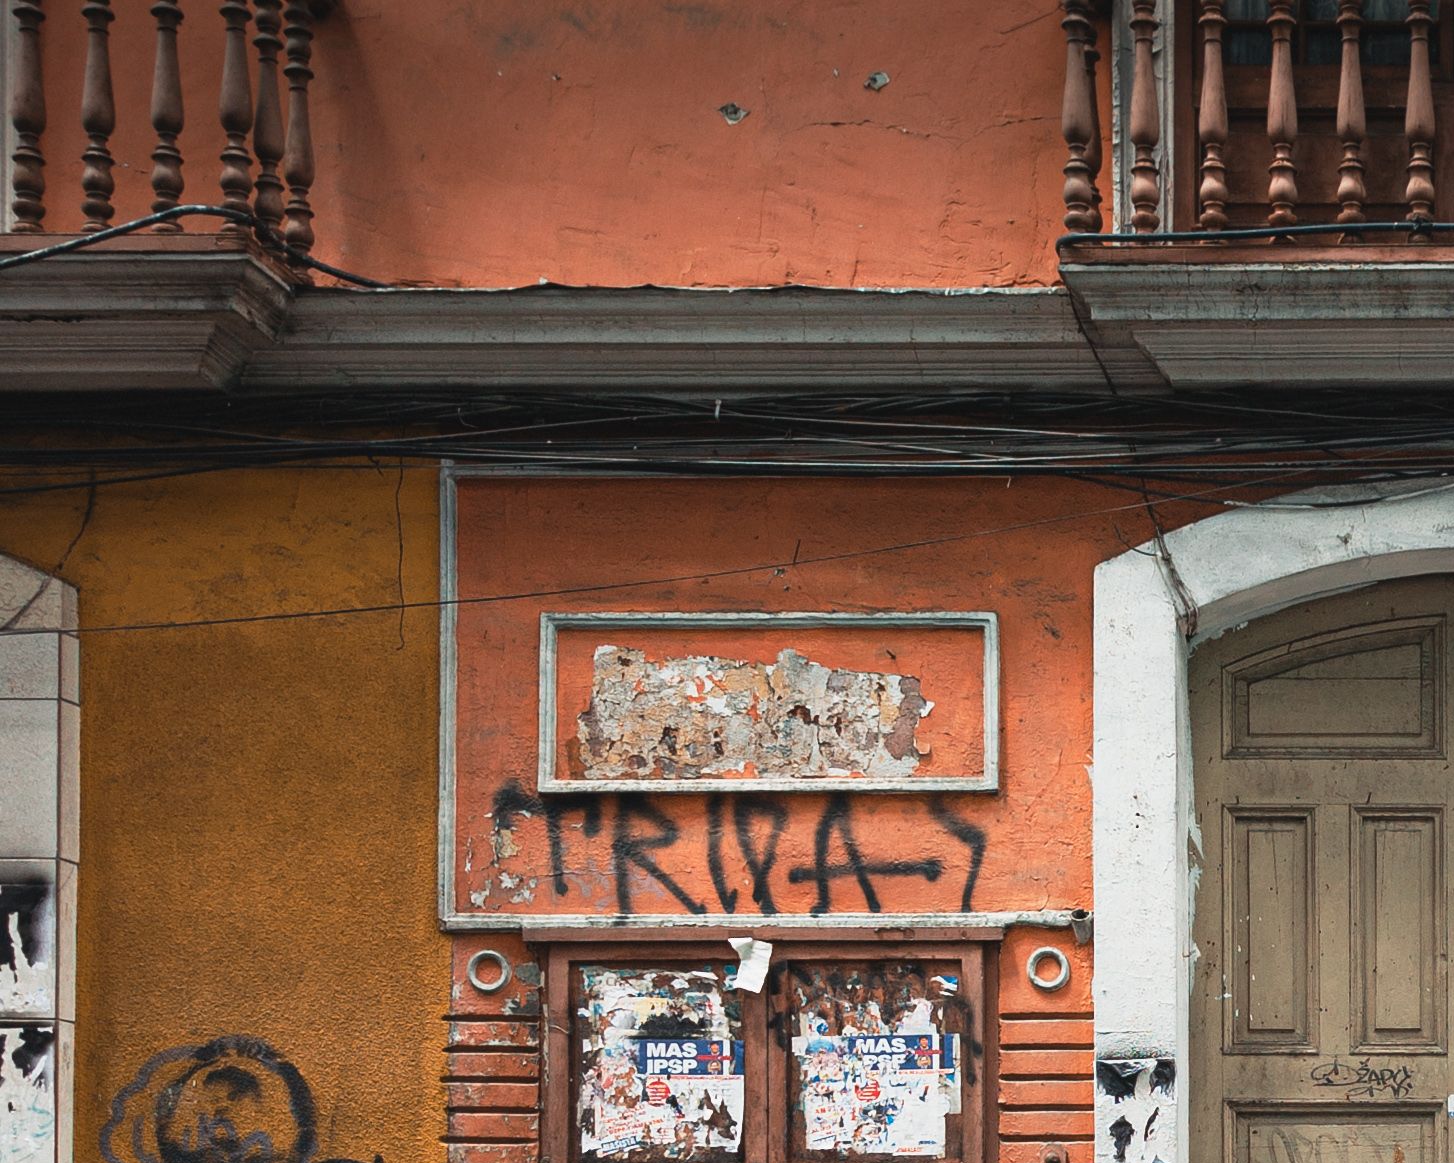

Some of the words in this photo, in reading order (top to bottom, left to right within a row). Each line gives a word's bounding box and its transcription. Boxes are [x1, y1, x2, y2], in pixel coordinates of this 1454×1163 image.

[647, 1042, 698, 1058] MAS
[856, 1038, 907, 1054] MAS
[647, 1059, 698, 1074] IPSP
